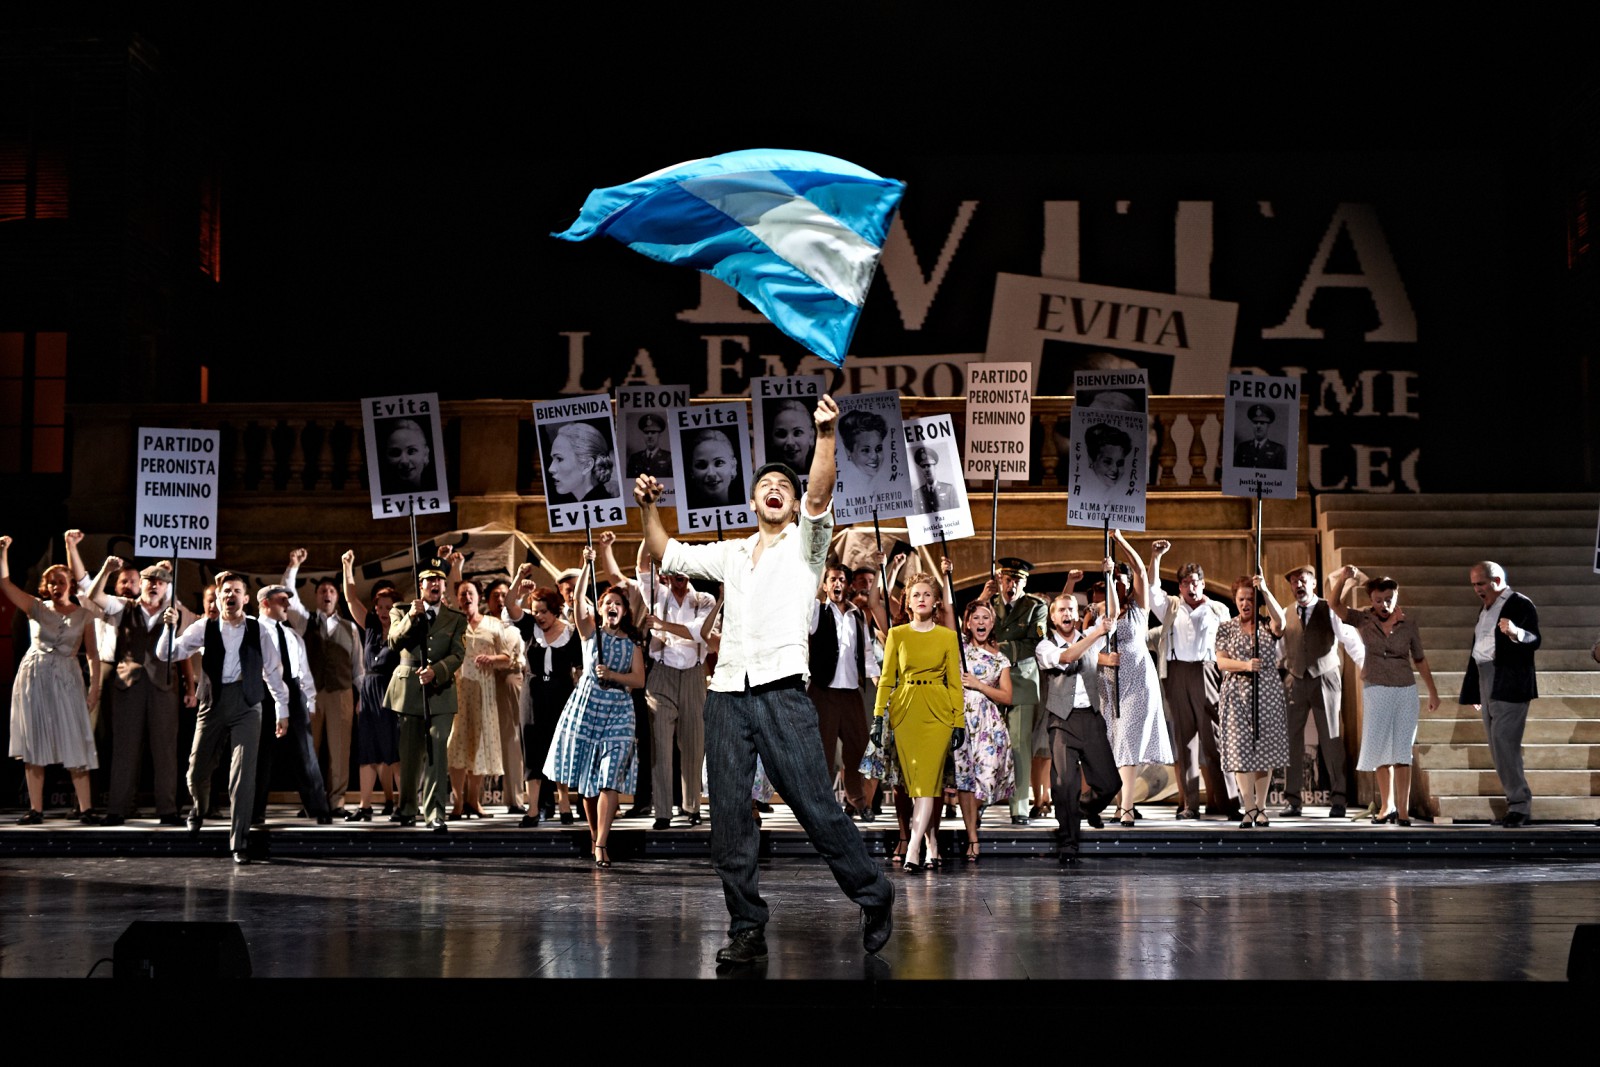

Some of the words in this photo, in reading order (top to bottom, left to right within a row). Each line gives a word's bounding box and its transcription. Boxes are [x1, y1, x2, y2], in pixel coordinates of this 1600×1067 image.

[1035, 293, 1189, 349] EVITA
[557, 331, 661, 395] LA
[971, 370, 1028, 384] PARTIDO
[1076, 374, 1145, 386] BIENVENIDA
[761, 378, 817, 396] Evita
[1229, 380, 1296, 400] PERON
[619, 390, 686, 408] PERON
[969, 390, 1029, 404] PERONISTA
[372, 398, 430, 416] Evita
[536, 400, 609, 420] BIENVENIDA
[678, 408, 738, 428] Evita
[972, 411, 1026, 425] FEMININO
[904, 421, 951, 442] ERON
[143, 435, 214, 453] PARTIDO
[971, 440, 1024, 454] NUESTRO
[140, 458, 216, 475] PERONISTA
[968, 460, 1026, 472] PORVENIR
[144, 481, 212, 498] FEMININO
[1239, 478, 1262, 486] justici
[382, 495, 440, 514] Evita
[846, 496, 867, 506] ALMA
[870, 495, 874, 504] Y
[876, 491, 902, 502] NERVIO
[550, 504, 622, 528] Evita
[836, 508, 852, 518] DEL
[854, 505, 873, 516] VOTO
[876, 500, 913, 512] FEMENINO
[1080, 502, 1100, 512] ALMA
[1104, 504, 1108, 512] Y
[1110, 504, 1136, 514] NERVIO
[144, 514, 210, 530] NUESTRO
[688, 509, 748, 529] Evita
[945, 520, 960, 528] social
[1069, 510, 1084, 520] DEL
[1087, 512, 1106, 520] VOTO
[1108, 513, 1145, 524] FEMENINO
[139, 534, 212, 551] PORVENIR
[933, 530, 954, 538] traajo
